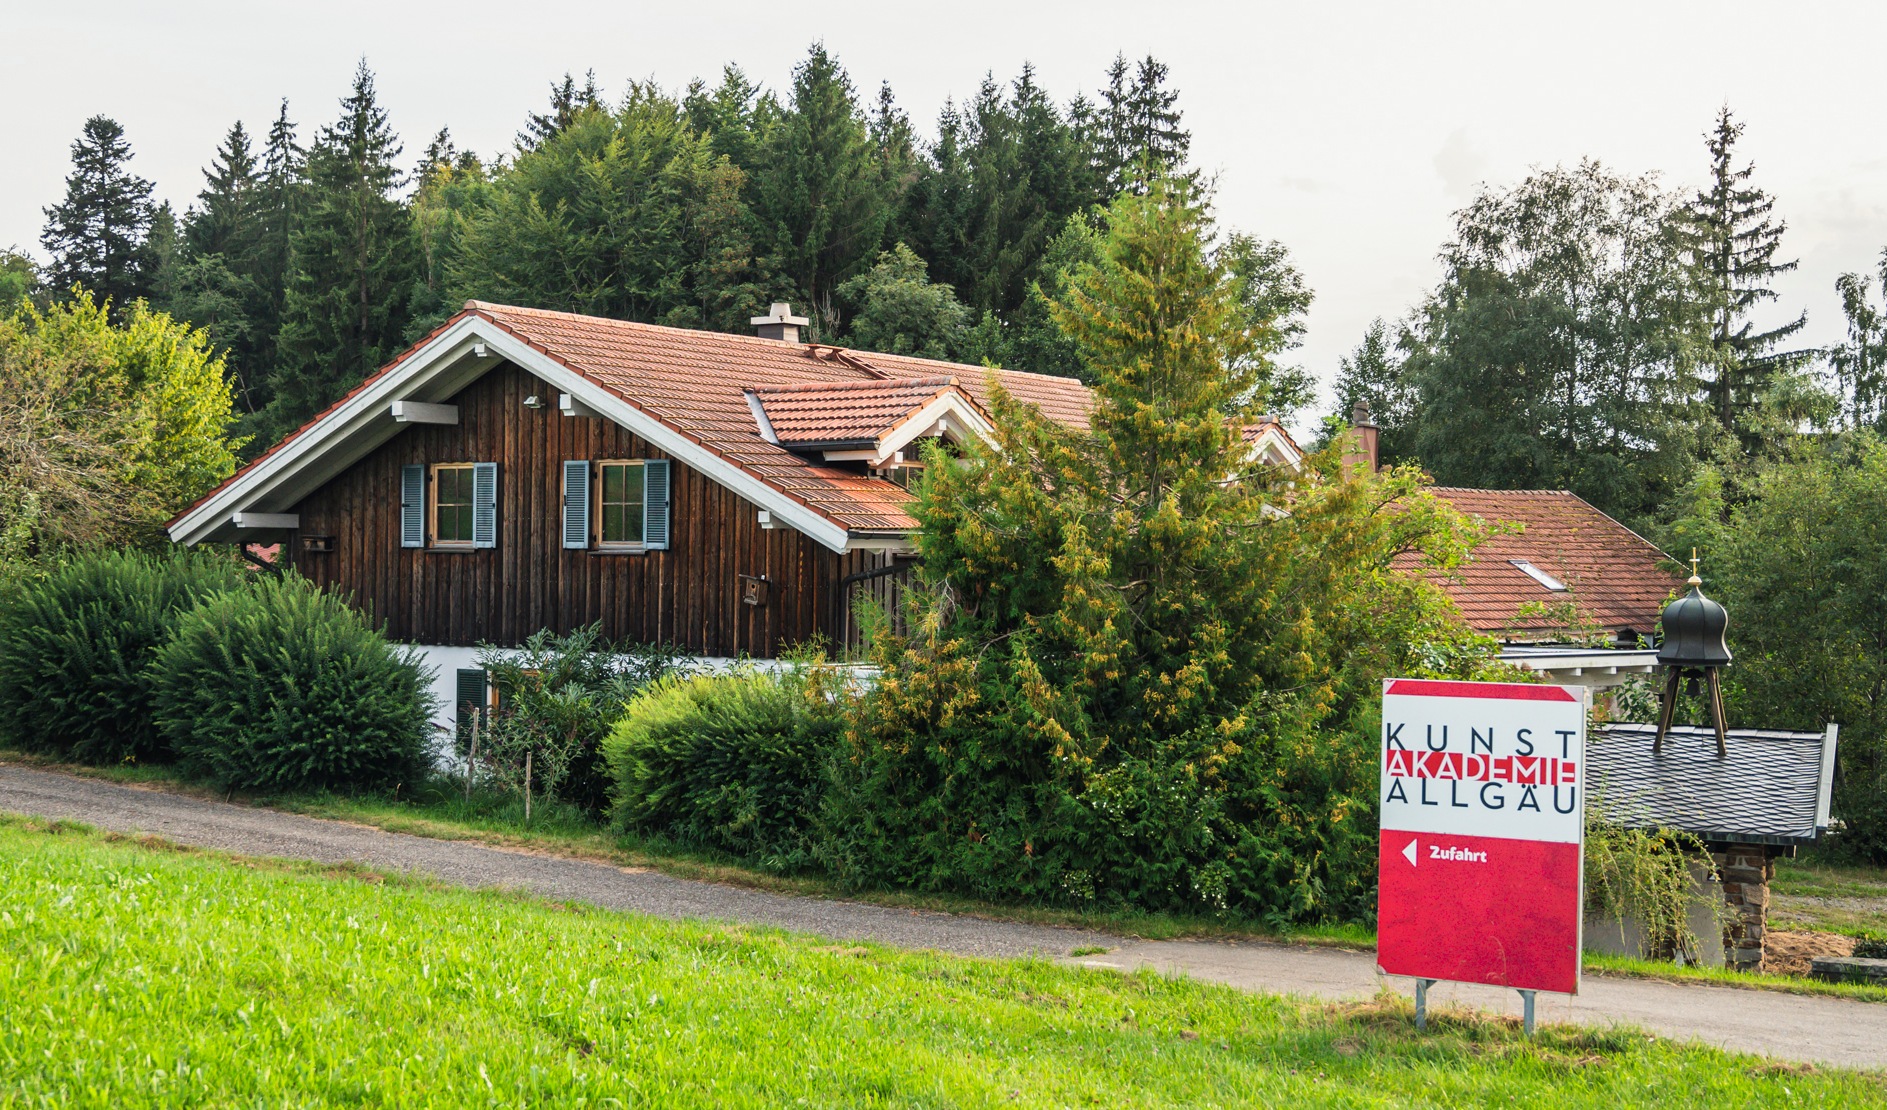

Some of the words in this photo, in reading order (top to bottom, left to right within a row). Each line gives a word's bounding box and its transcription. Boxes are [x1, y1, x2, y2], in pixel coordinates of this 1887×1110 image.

[1386, 722, 1576, 759] KUNST
[1386, 748, 1576, 786] AKADEMIE
[1386, 777, 1576, 814] ALLGÄU
[1429, 845, 1487, 863] Zufahrt
